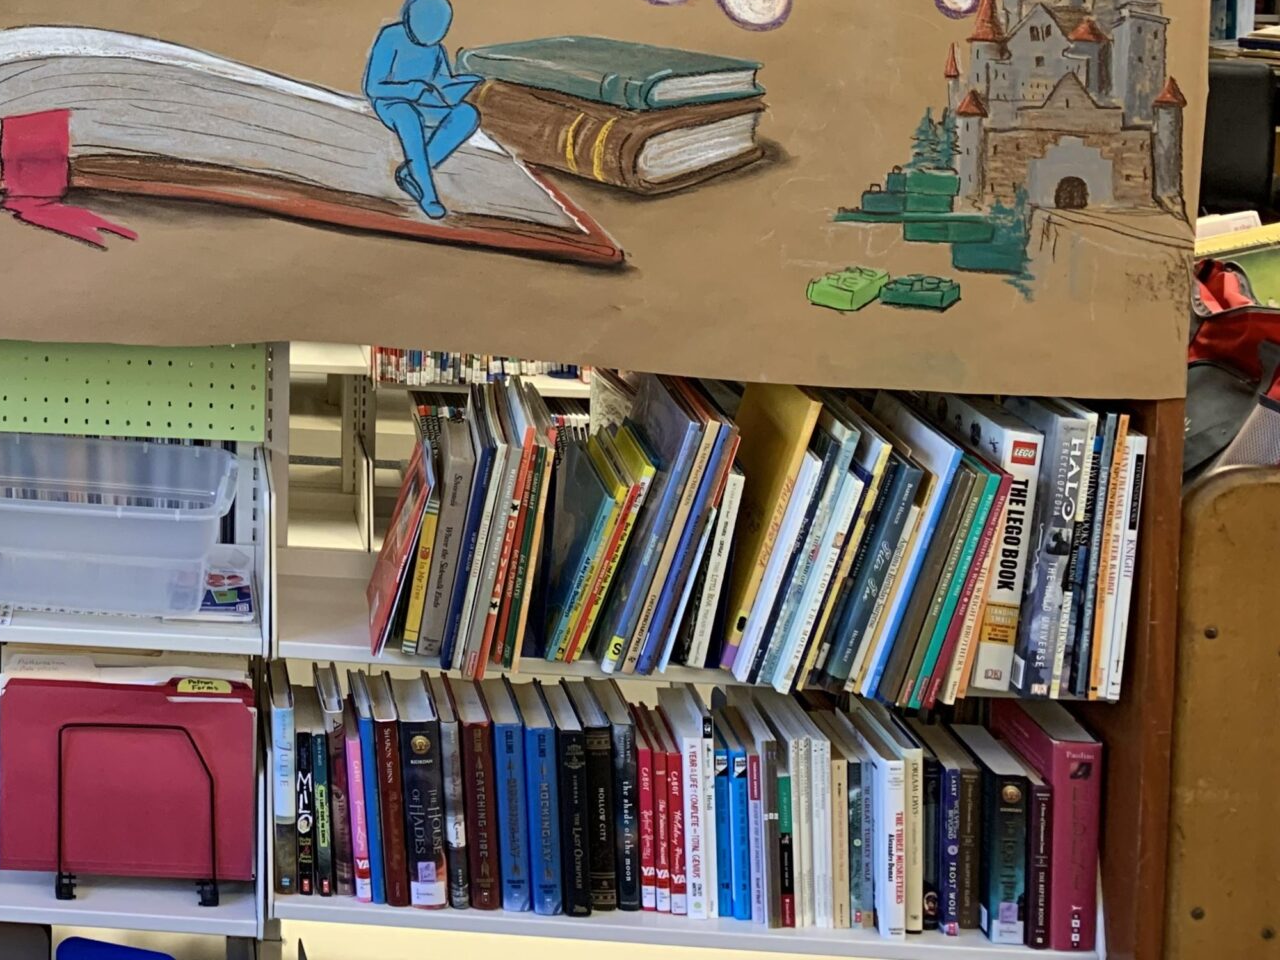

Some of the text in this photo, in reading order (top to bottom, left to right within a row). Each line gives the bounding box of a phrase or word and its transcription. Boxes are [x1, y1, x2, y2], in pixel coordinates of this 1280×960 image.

[1014, 448, 1035, 458] LEGO
[504, 468, 517, 499] WELCOME
[1054, 441, 1071, 517] ENCYCLOPEDIA
[1061, 437, 1085, 523] HALO
[1100, 470, 1109, 485] SPY
[1112, 466, 1120, 481] SPY
[450, 473, 464, 507] Silverstein
[503, 501, 509, 509] TO
[1081, 453, 1100, 544] EYEWITNESS BOOKS
[1096, 487, 1107, 522] EXTREME
[1131, 460, 1144, 522] EYEWITNESS BOOKS
[963, 495, 979, 528] WELCOME
[1107, 445, 1131, 595] GIANT TREASURY PETER RABBIT
[492, 536, 502, 559] WORLD
[757, 515, 782, 568] New York
[960, 528, 968, 538] TO
[965, 494, 1007, 596] WELCOME TO JOSEFINA'S WORLD
[998, 478, 1029, 591] THE LEGO BOOK
[434, 526, 454, 608] Where the Sidewalk Ends
[495, 519, 516, 593] OLIVIA
[581, 564, 589, 575] My
[803, 549, 817, 574] WIZARD
[827, 551, 839, 570] THE
[960, 554, 972, 578] WORLD
[1124, 539, 1136, 578] KNIGHT
[416, 570, 426, 583] My
[576, 575, 585, 590] Little
[861, 539, 896, 605] Peter Pan
[868, 537, 909, 630] Angelina's Birthday Surprise
[940, 572, 952, 596] WORLD
[1100, 564, 1108, 584] Picture
[415, 584, 424, 601] Tree
[565, 589, 580, 619] Ducklings
[706, 573, 721, 608] LITTLE BEAR
[1057, 523, 1082, 655] VISUAL TIMELINE INVENTIONS
[1088, 582, 1096, 601] Book
[633, 594, 658, 653] CHECKERBOARD PRESS
[806, 607, 818, 627] THE
[955, 566, 989, 672] THE WRIGHT BROTHERS
[1035, 561, 1058, 667] THE HALO UNIVERSE
[1085, 610, 1093, 628] Picture
[612, 643, 624, 656] S
[793, 629, 810, 661] MOUSE
[277, 740, 293, 786] JULIE
[385, 727, 395, 783] SHARON SHINN
[690, 750, 698, 767] YEAR
[623, 781, 632, 795] the
[672, 771, 680, 795] CABOT
[691, 774, 699, 788] LIFE
[410, 788, 428, 854] OF HADES
[428, 788, 445, 854] THE HOUSE
[477, 771, 489, 857] CATCHING FIRE
[541, 782, 553, 861] MOCKINGJAY
[624, 798, 632, 824] shade
[691, 794, 700, 826] COMPLETE
[573, 827, 584, 847] LAST
[625, 827, 633, 837] of
[671, 810, 683, 845] Holiday
[625, 839, 633, 854] the
[693, 835, 701, 852] TOTAL
[574, 848, 586, 888] OLYMPIAN
[642, 866, 655, 876] YA
[656, 869, 669, 878] YA
[672, 875, 685, 884] YA
[693, 854, 702, 878] GENIUS
[897, 854, 905, 904] MUSKETEERS
[949, 892, 957, 915] WOLF
